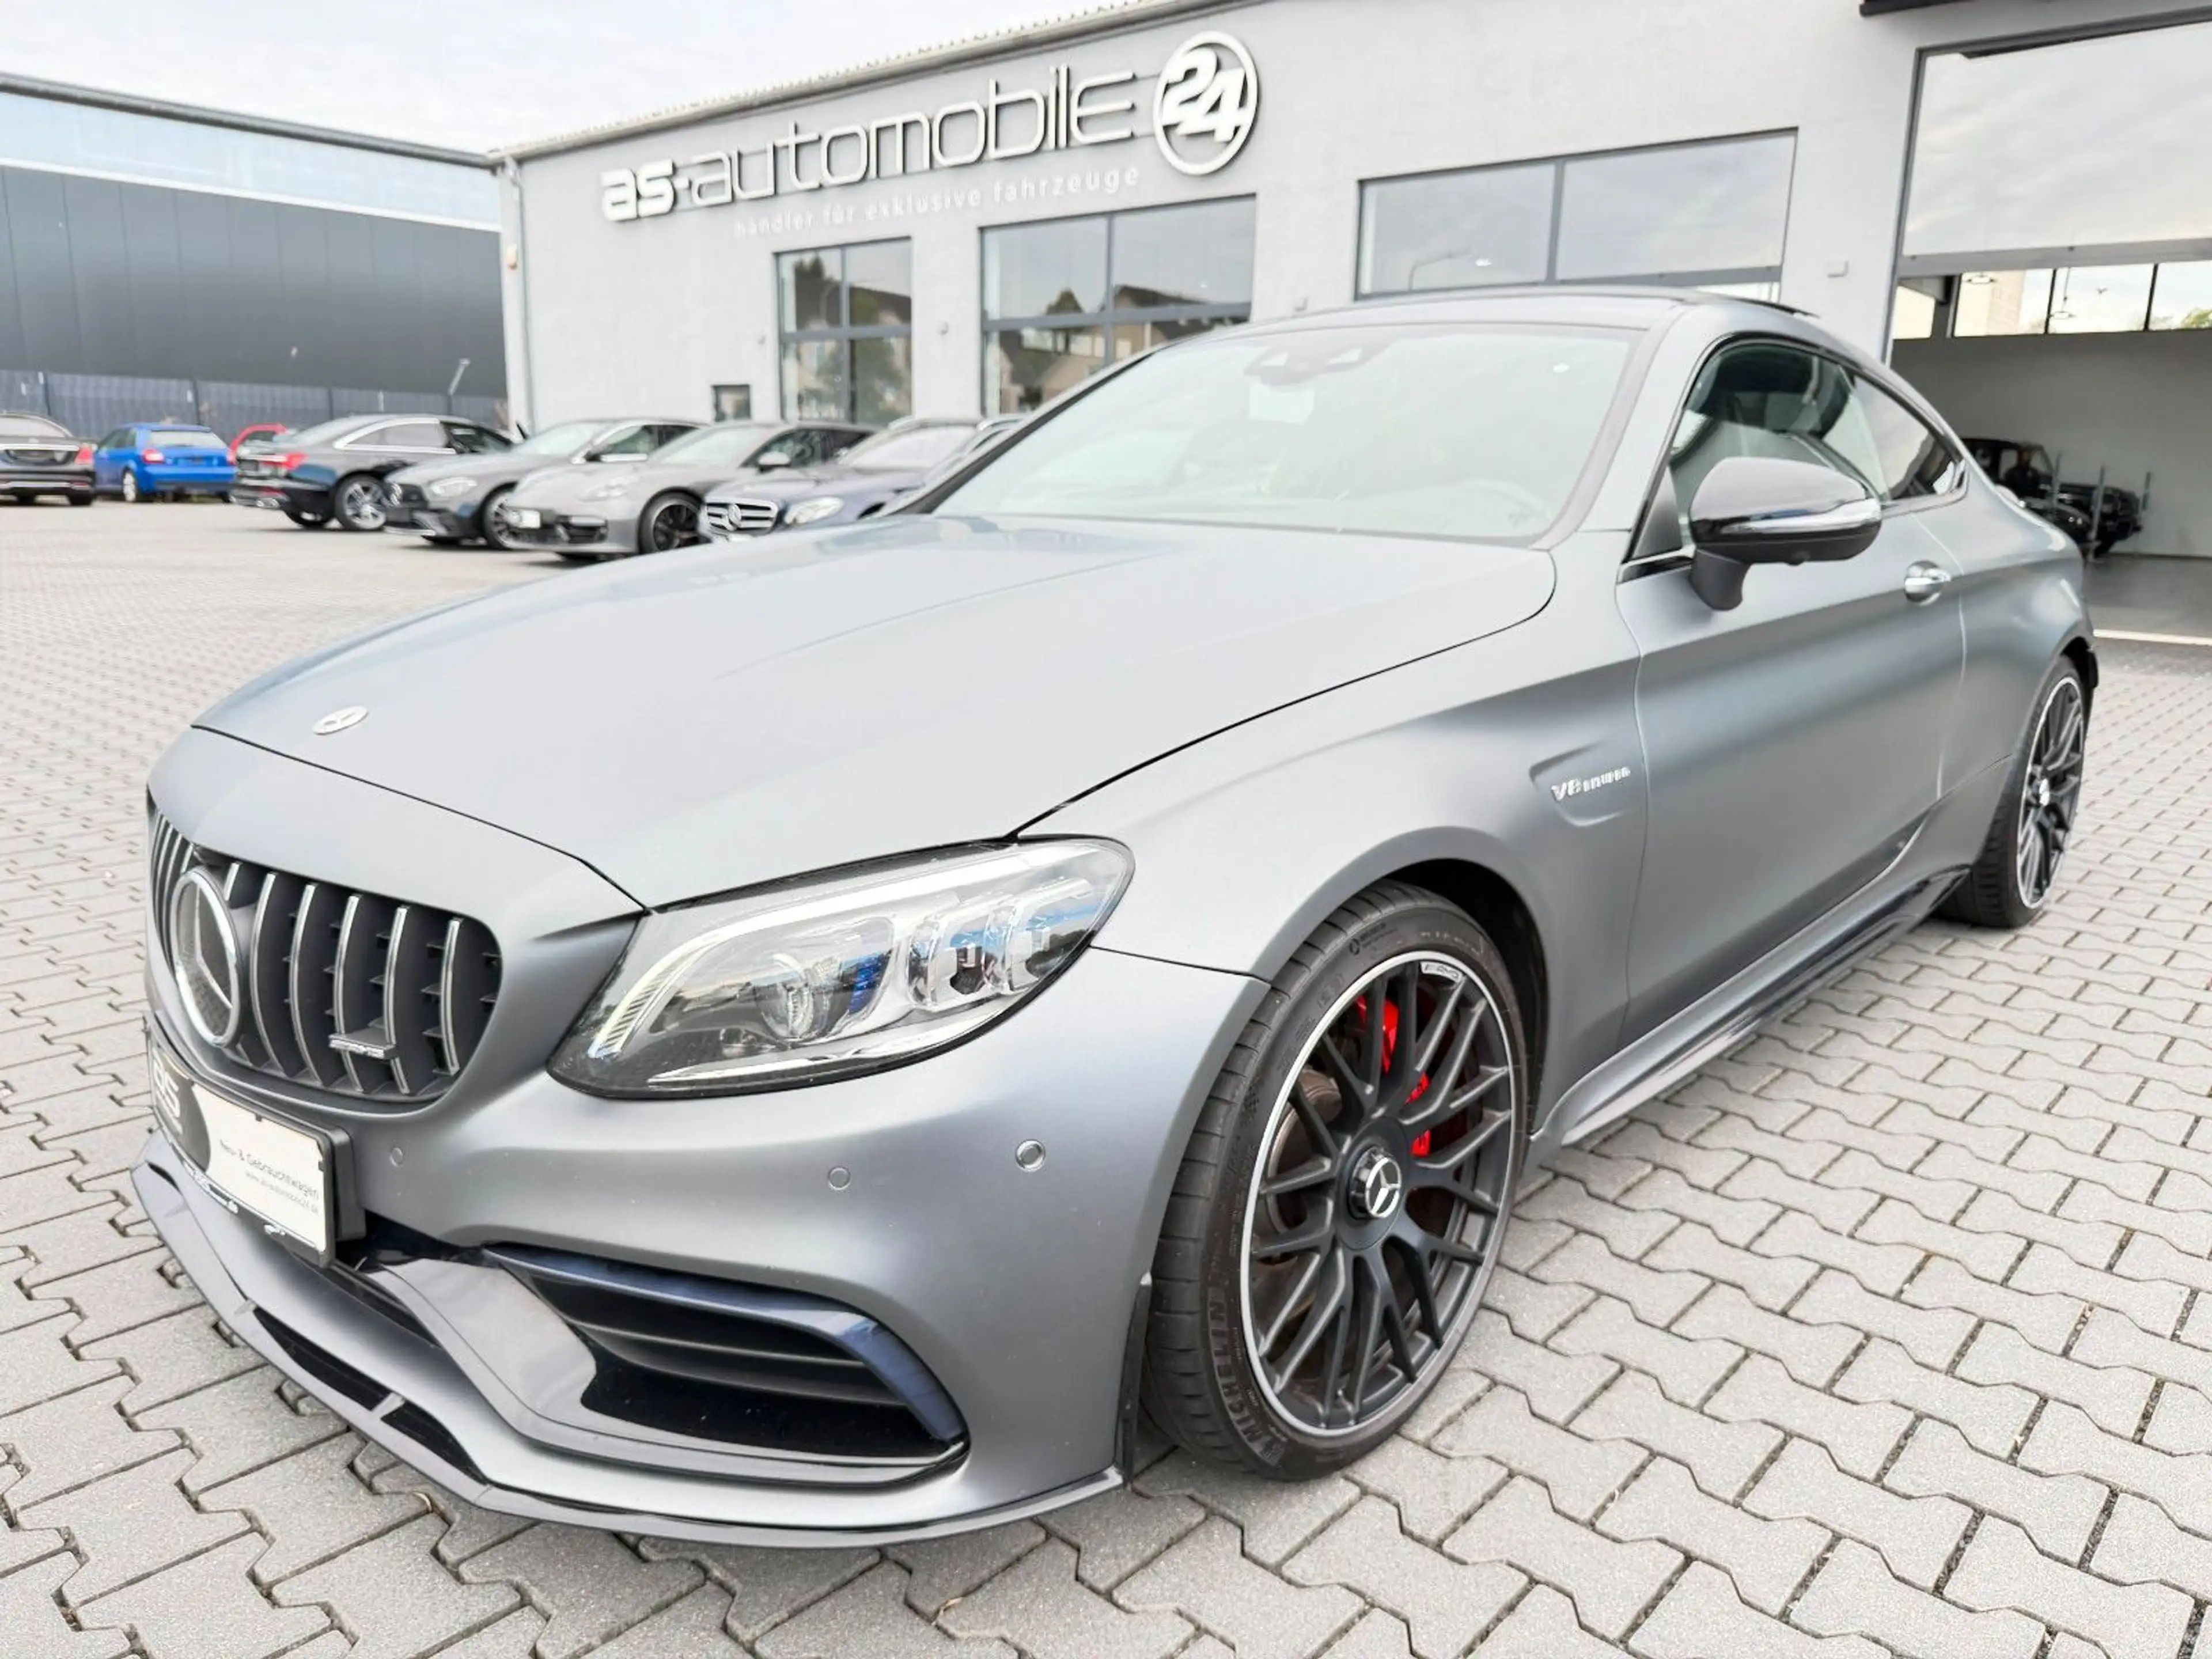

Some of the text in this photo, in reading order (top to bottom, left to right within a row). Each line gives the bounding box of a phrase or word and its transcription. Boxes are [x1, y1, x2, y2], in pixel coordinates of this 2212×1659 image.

[1161, 47, 1247, 143] 24
[821, 204, 854, 225] für
[865, 187, 982, 222] exklusive
[993, 166, 1139, 203] fahrzeuge
